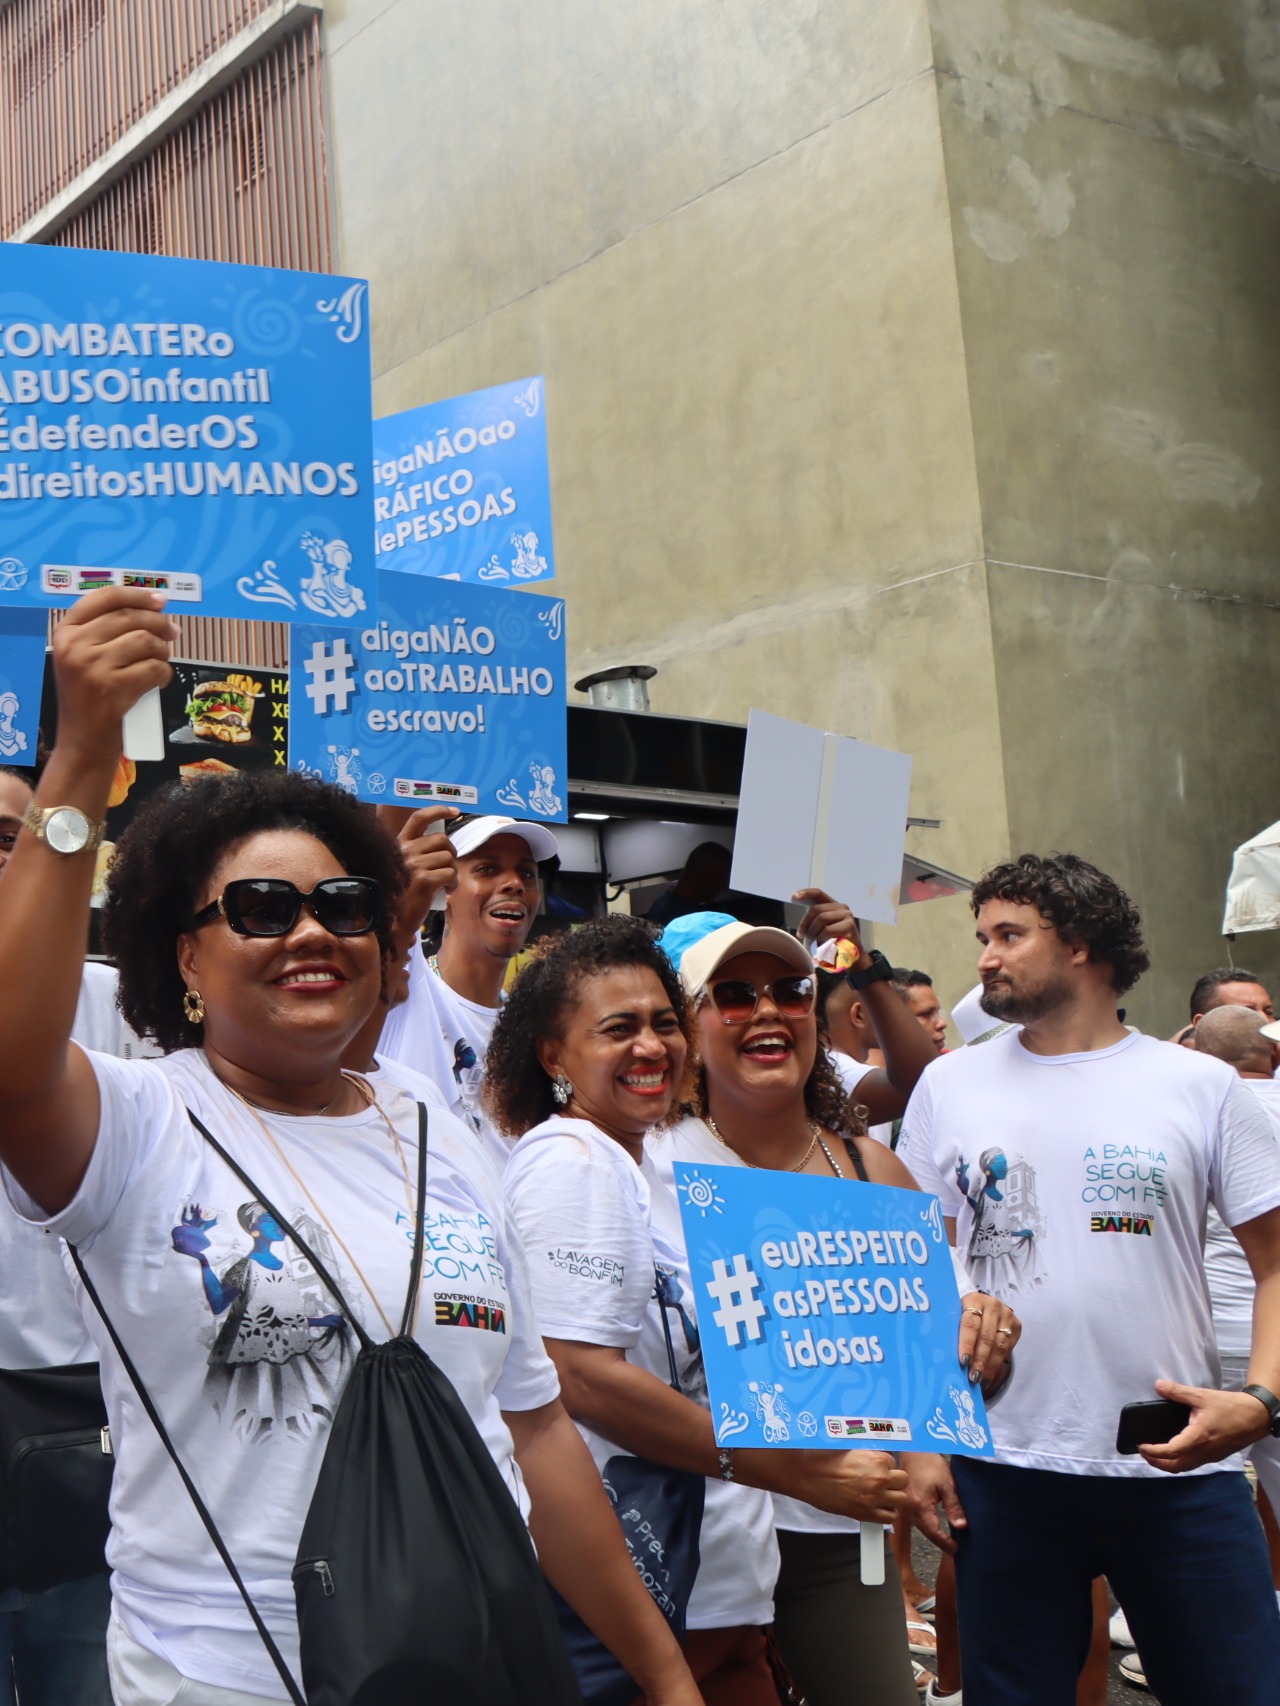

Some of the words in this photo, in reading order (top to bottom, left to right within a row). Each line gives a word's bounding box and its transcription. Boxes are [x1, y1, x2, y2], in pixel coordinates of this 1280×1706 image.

[364, 662, 554, 696] aoTRABALHO
[367, 704, 486, 733] escravo!
[1086, 1162, 1166, 1186] SEGUE
[1081, 1184, 1136, 1203] COM
[1132, 1212, 1155, 1221] ESTADO
[556, 1248, 625, 1277] LAVAGEM
[761, 1230, 930, 1269] euRESPEITO
[433, 1292, 475, 1303] GOVERNO
[476, 1296, 487, 1305] DO
[773, 1277, 931, 1319] asPESSOAS
[783, 1328, 885, 1369] idosas
